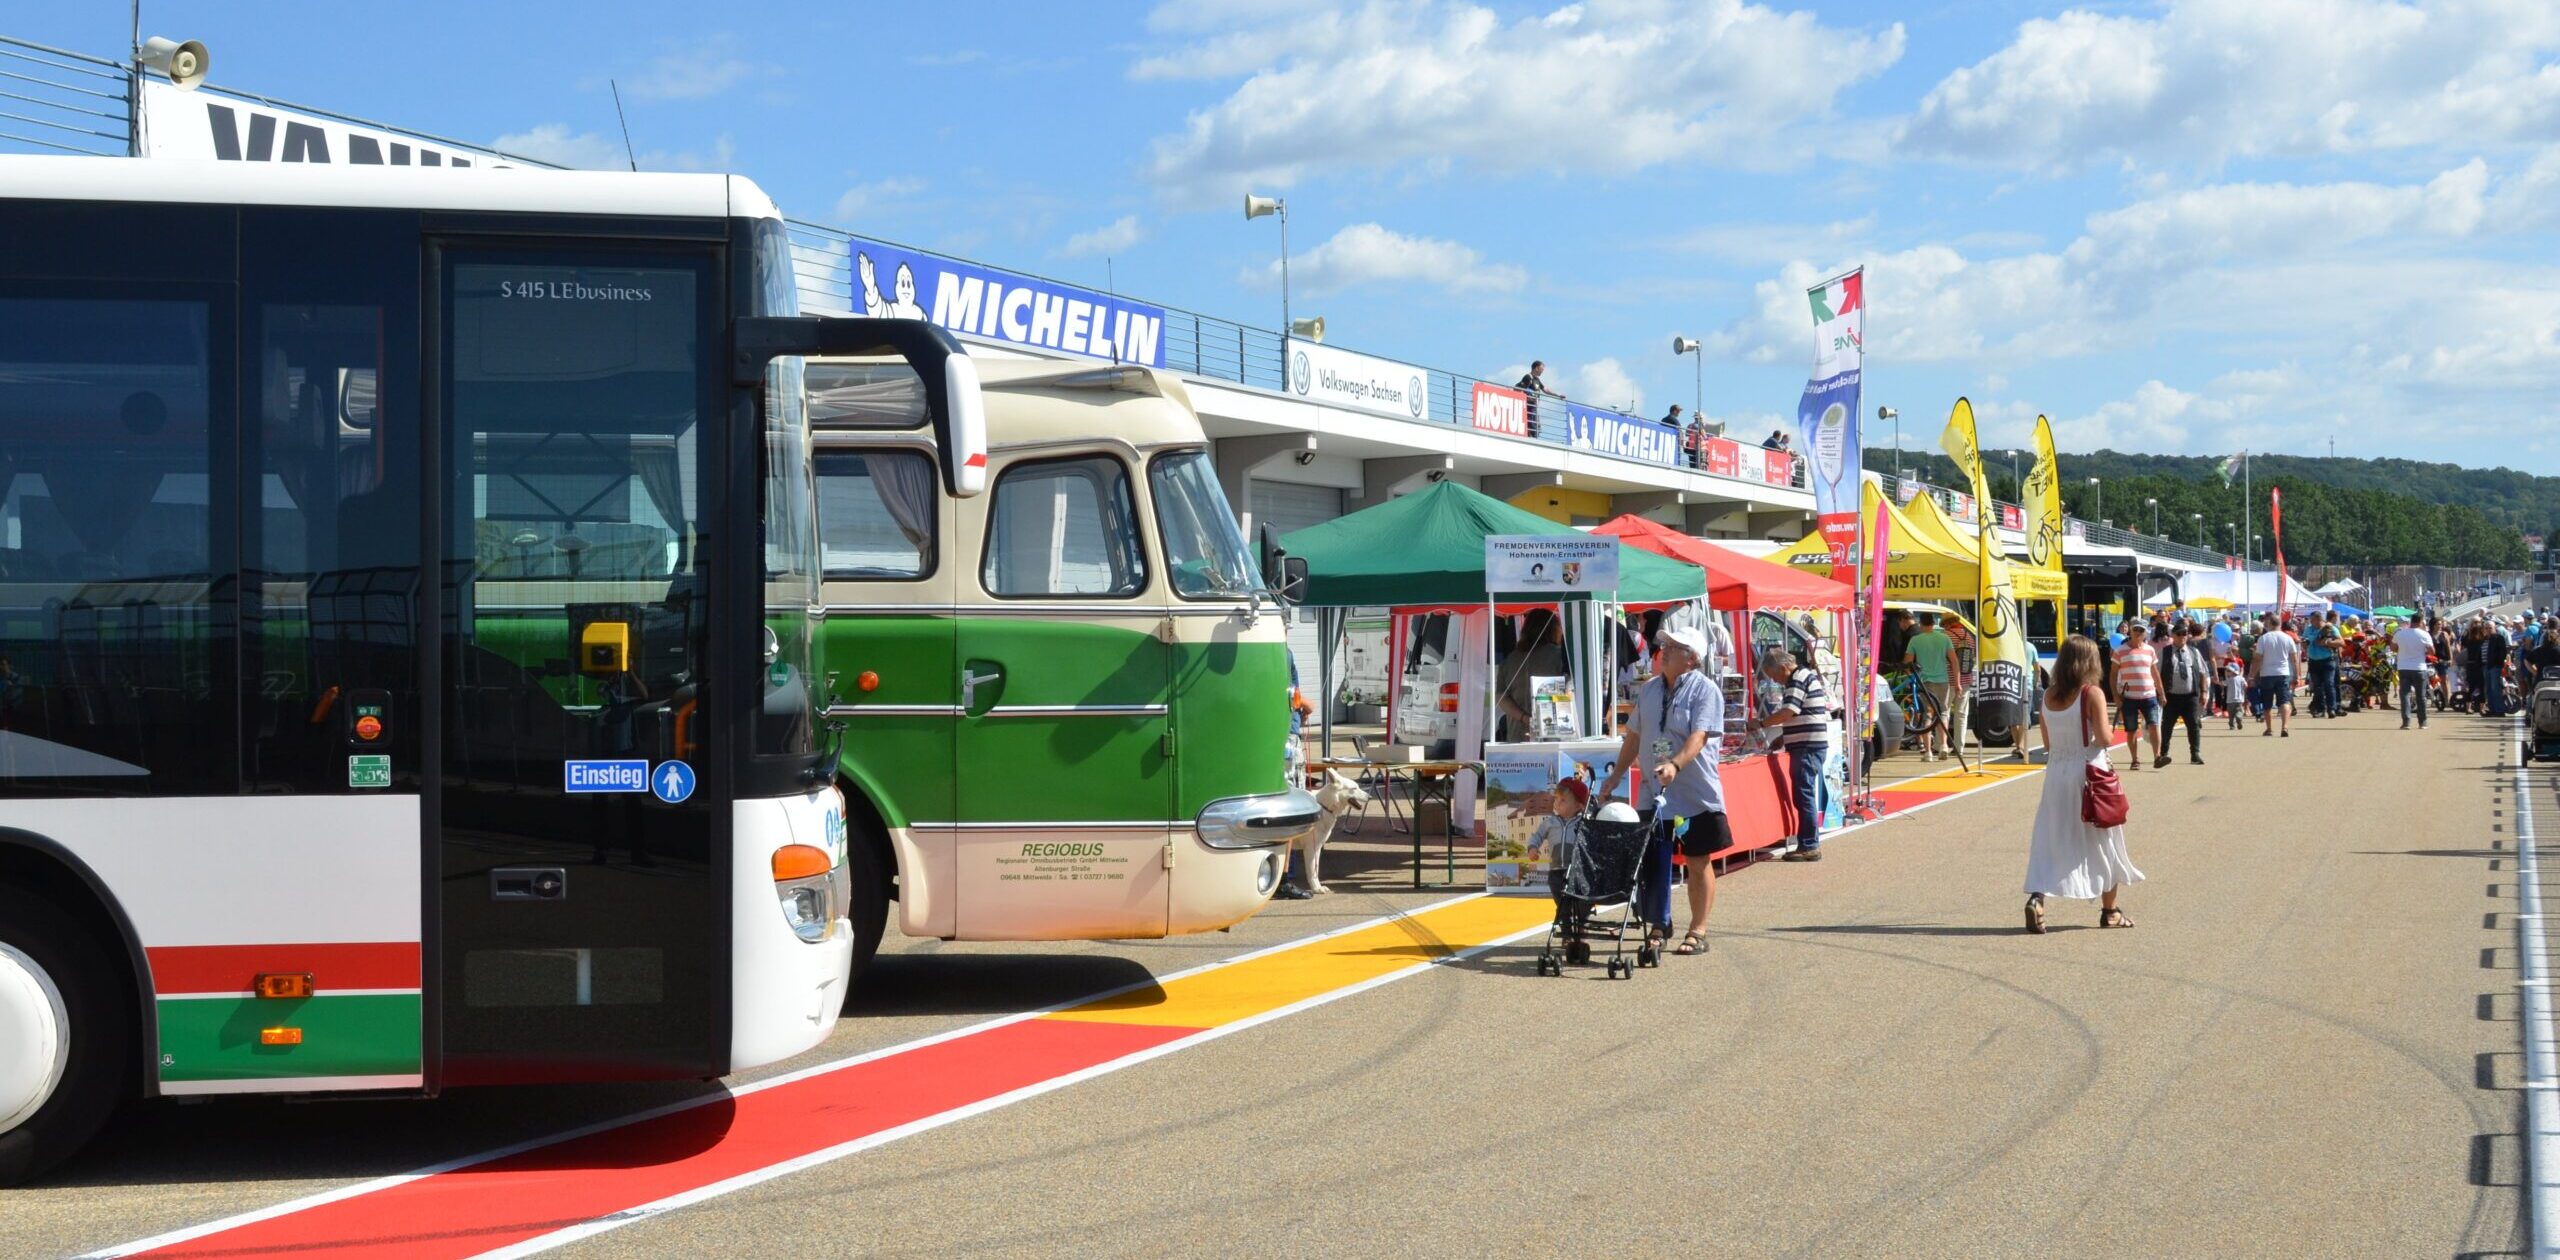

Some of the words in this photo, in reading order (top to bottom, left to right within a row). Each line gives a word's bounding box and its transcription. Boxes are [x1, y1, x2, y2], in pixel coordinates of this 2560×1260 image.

[501, 281, 513, 298] S
[516, 281, 545, 298] 415
[550, 282, 652, 301] LEbusiness
[932, 271, 1160, 367] MICHELIN
[1319, 367, 1369, 400] Volkswagen
[1371, 382, 1402, 403] Sachsen
[1475, 390, 1526, 435] MOTUL
[1593, 416, 1677, 466] MICHELIN
[1494, 542, 1611, 550] FREMDENVERKEHRSVEREIN
[1509, 551, 1596, 559] Hohenstein-Ernstthal
[1866, 574, 1941, 589] GNSTIG!
[1981, 663, 2020, 678] UCKY
[1979, 676, 2019, 694] BIKE
[571, 764, 643, 789] Einstieg
[1021, 843, 1104, 857] REGIOBUS
